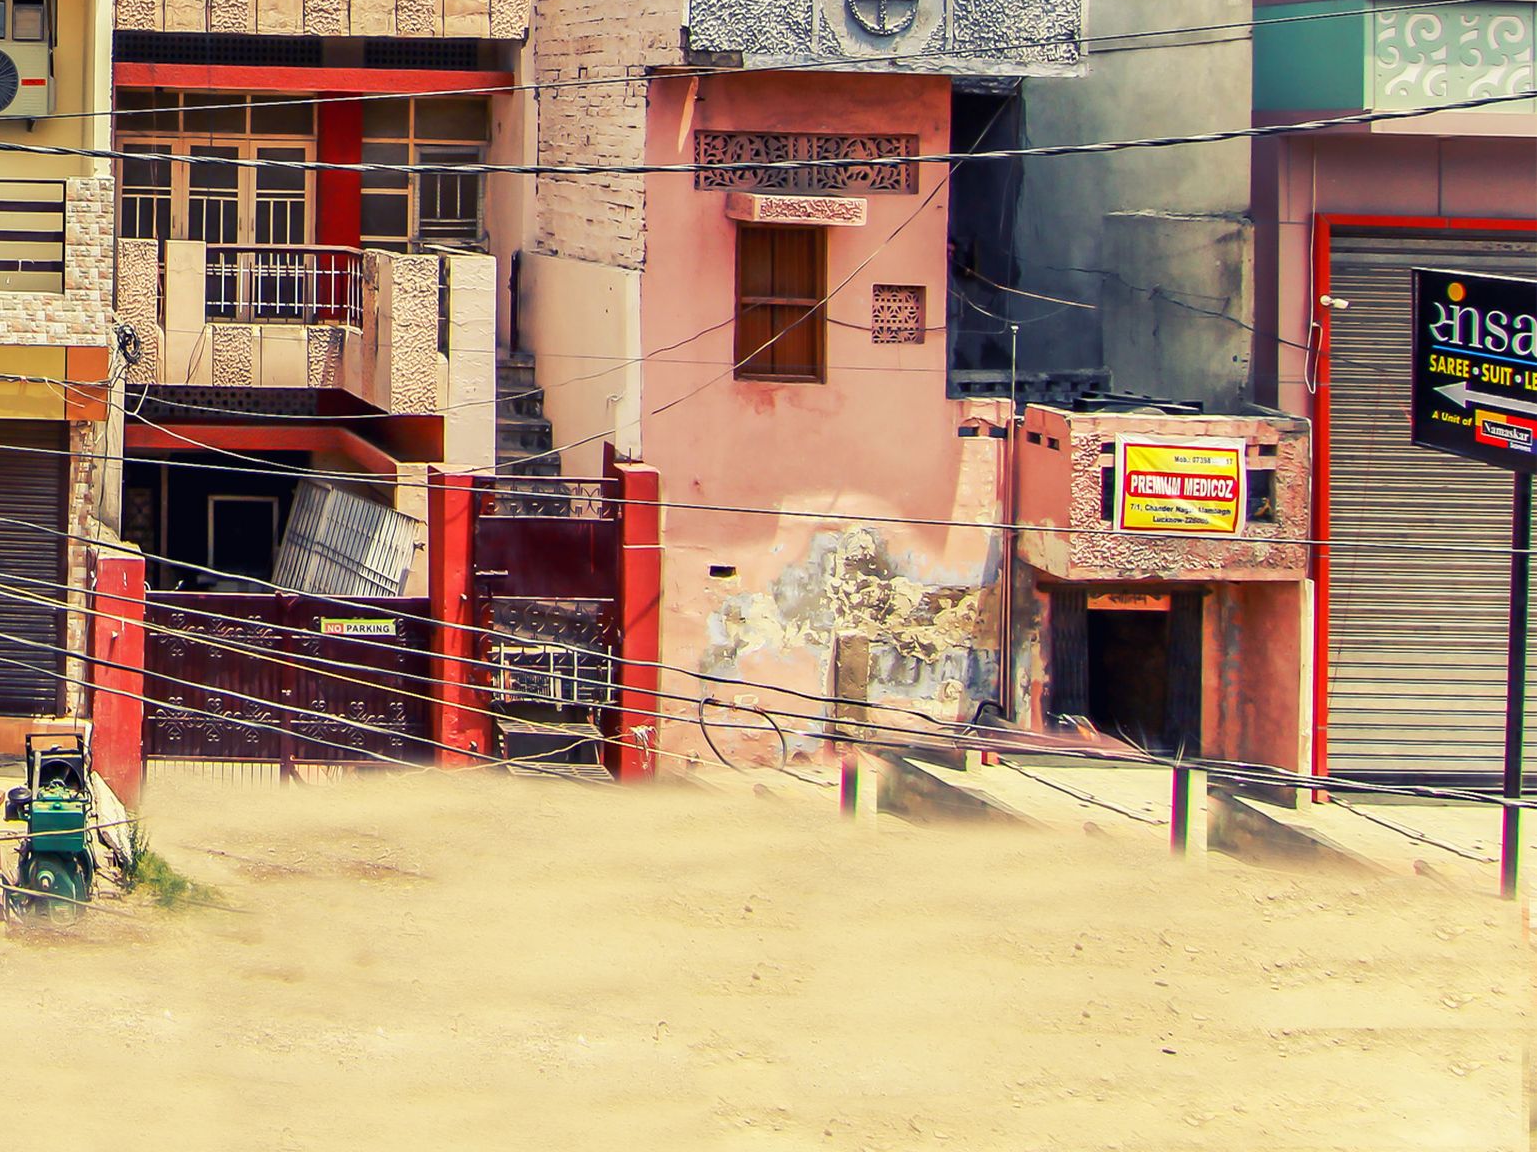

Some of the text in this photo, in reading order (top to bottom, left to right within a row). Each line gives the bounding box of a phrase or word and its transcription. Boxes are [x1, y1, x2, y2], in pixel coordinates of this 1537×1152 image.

[1429, 354, 1470, 378] SAREE
[1481, 363, 1513, 386] SUIT
[1431, 410, 1530, 442] A Unit of Namaskar
[1183, 477, 1234, 498] MEDICOZ
[327, 624, 390, 633] NO PARKING
